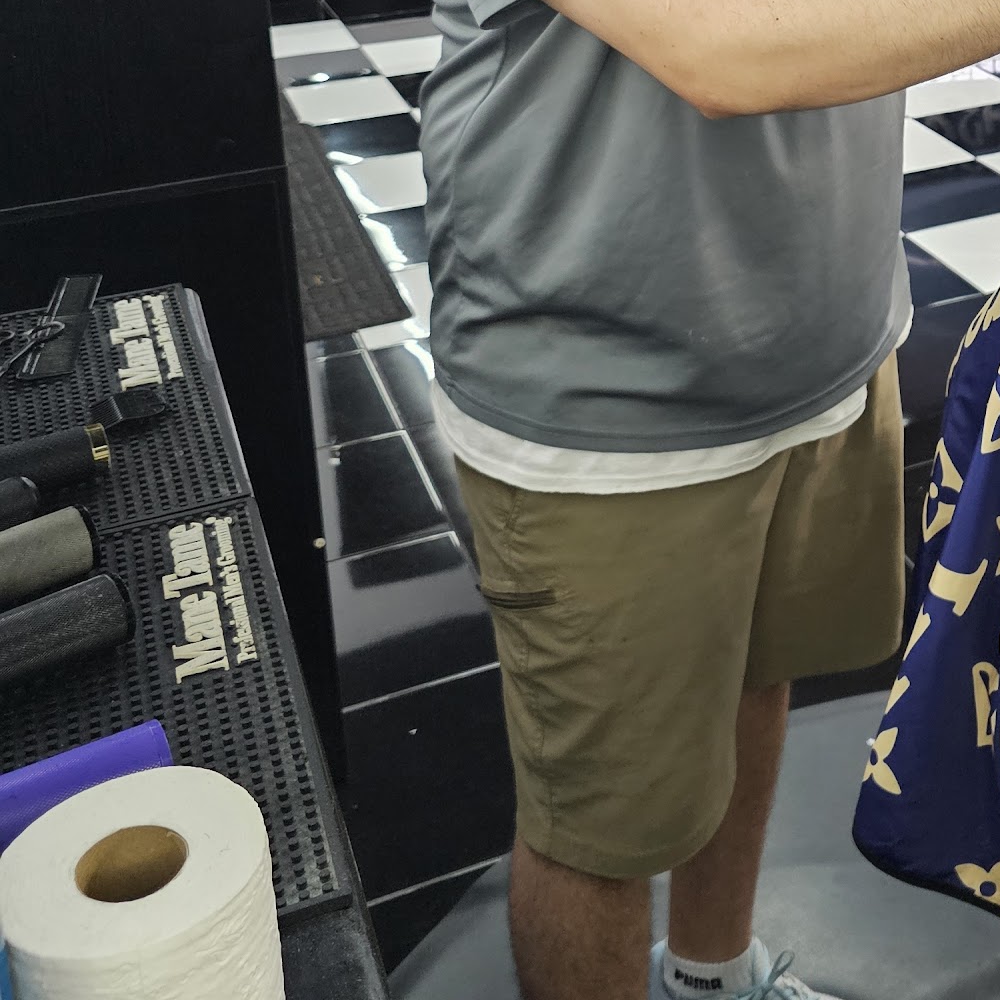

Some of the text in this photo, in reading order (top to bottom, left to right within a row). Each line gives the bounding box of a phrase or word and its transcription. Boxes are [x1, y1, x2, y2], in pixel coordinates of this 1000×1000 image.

[109, 297, 163, 392] Mane Tame
[162, 522, 230, 684] Mane Tame
[211, 516, 257, 664] Professional Men's Grooming
